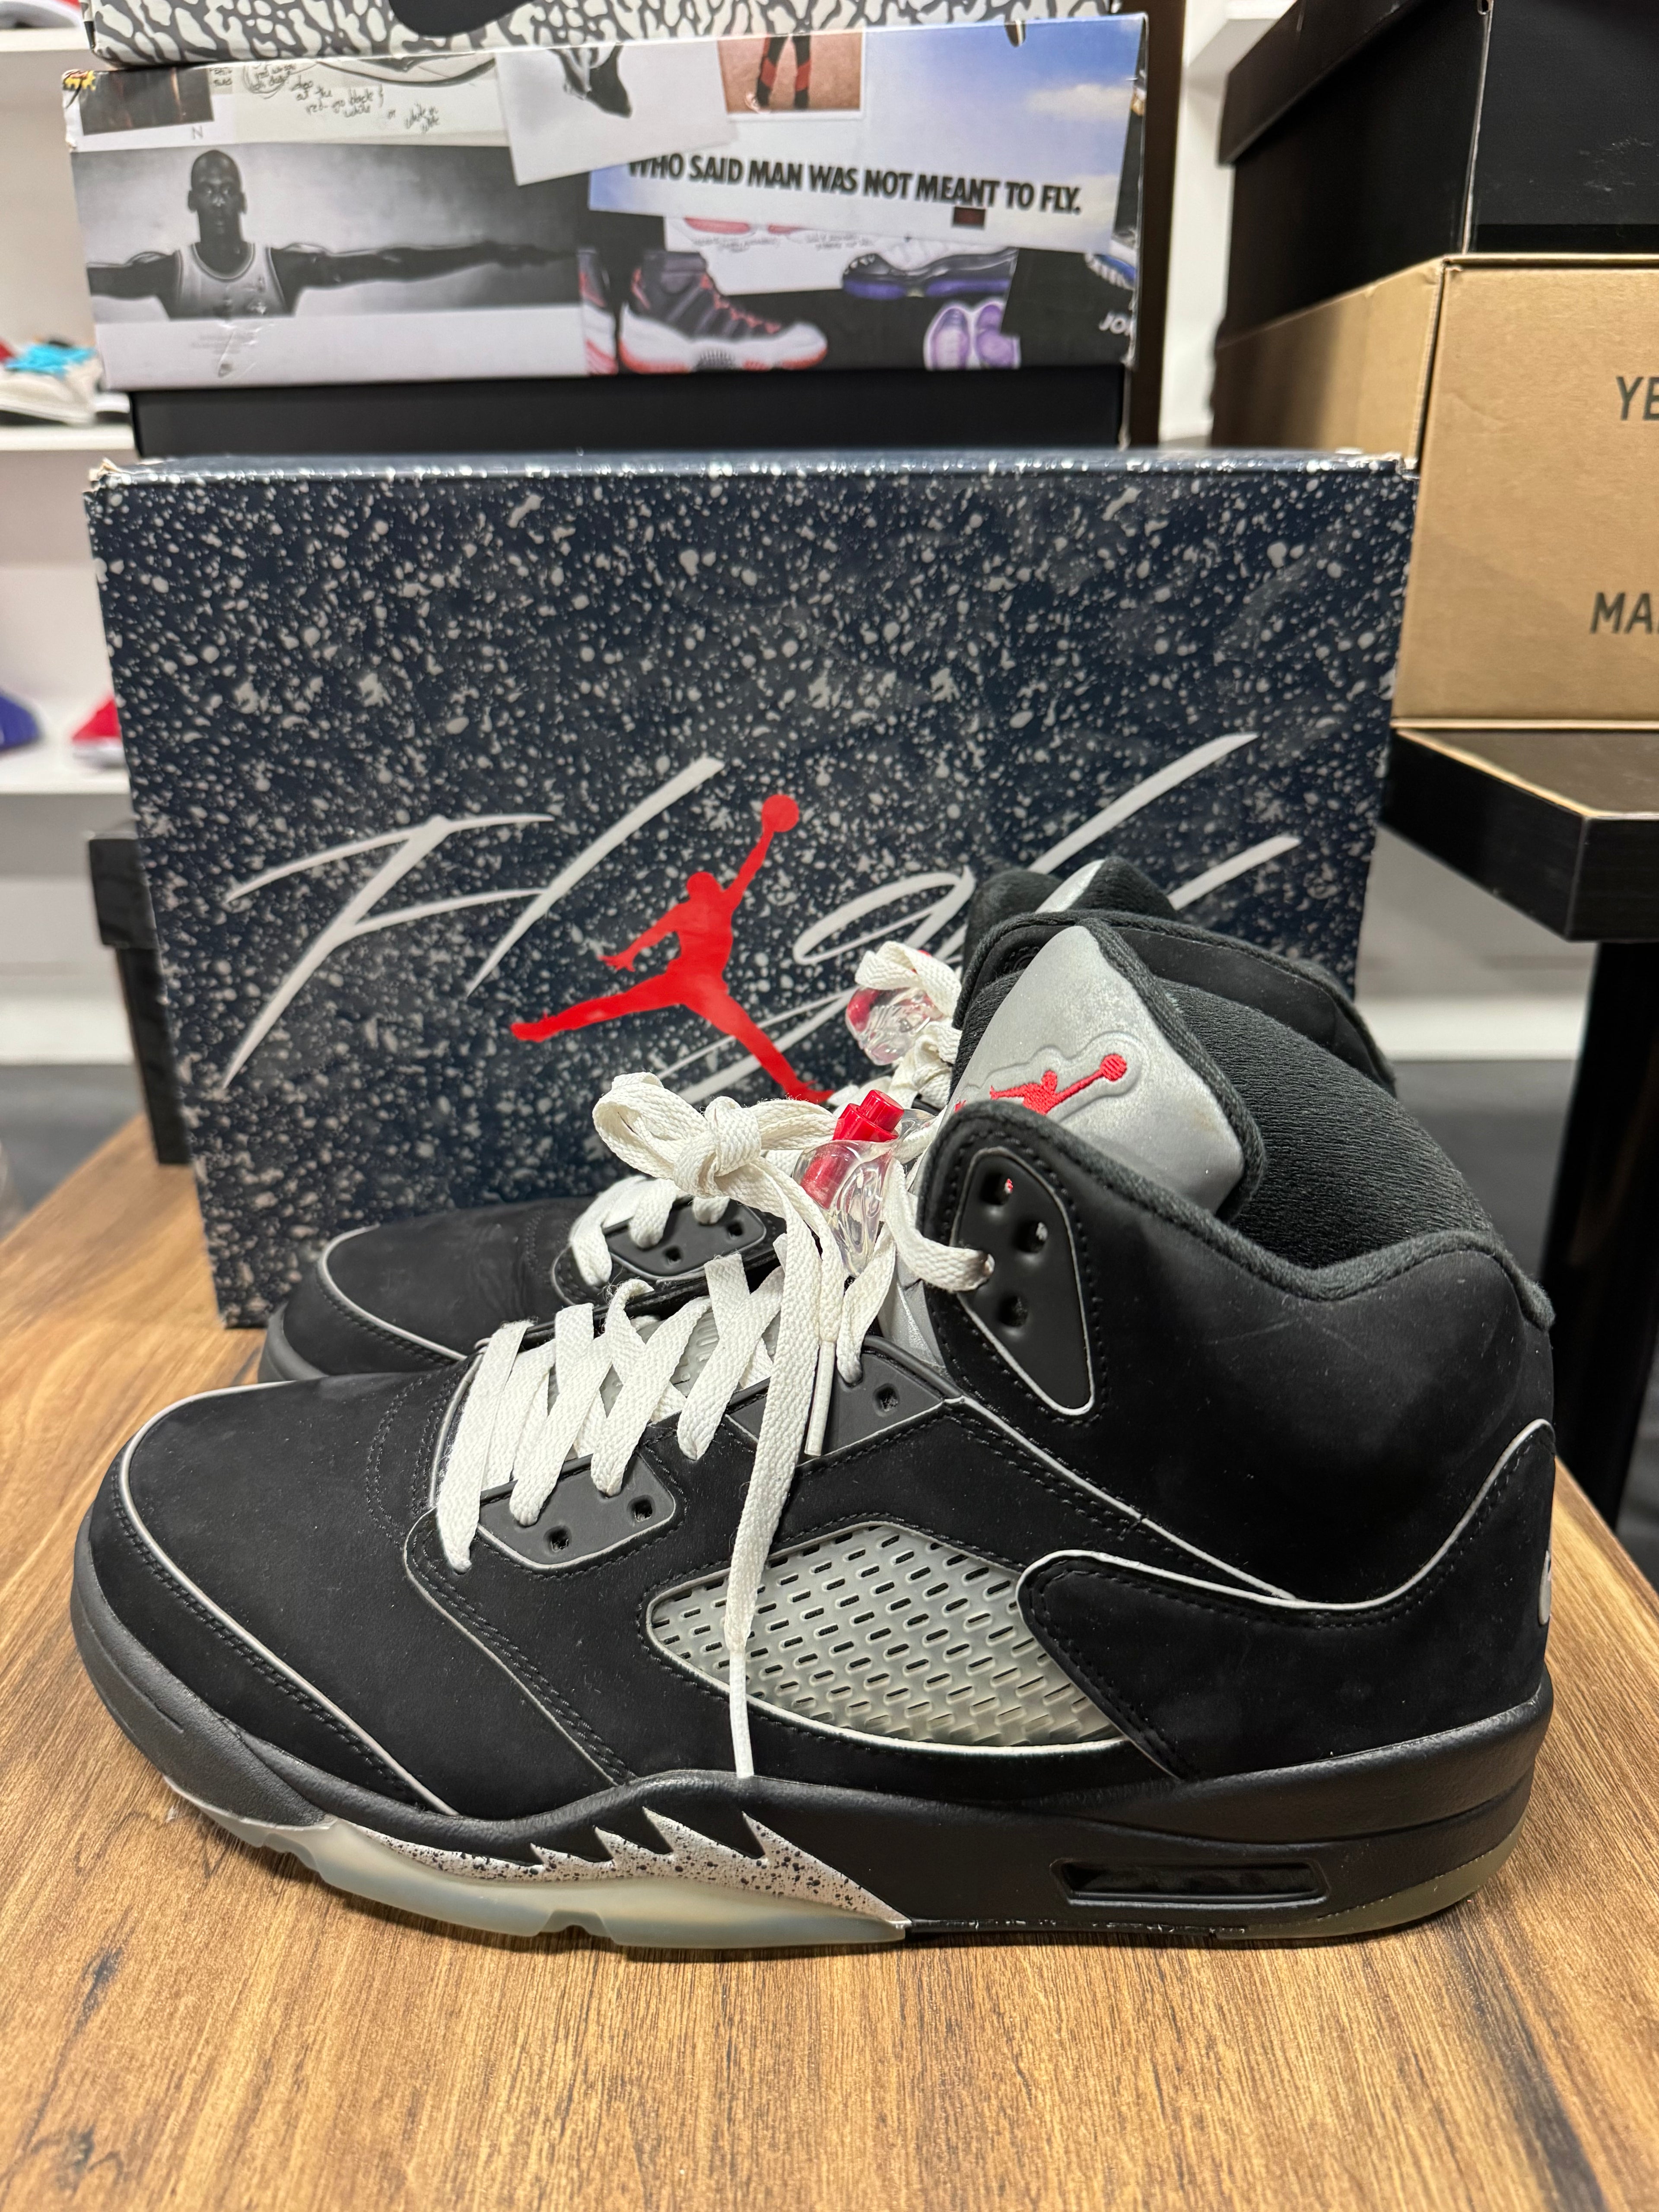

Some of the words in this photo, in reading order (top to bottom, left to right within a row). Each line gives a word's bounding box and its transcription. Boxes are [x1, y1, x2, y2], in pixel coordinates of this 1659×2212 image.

[192, 125, 204, 140] N
[628, 153, 684, 178] WHO
[688, 155, 744, 184] SAID
[747, 160, 802, 190] MAN
[809, 164, 858, 194] WAS
[864, 169, 913, 197] NOT
[915, 174, 1000, 206] MEANT
[1005, 181, 1034, 209] TO
[1039, 184, 1082, 216] FLY.
[1589, 591, 1659, 634] MA
